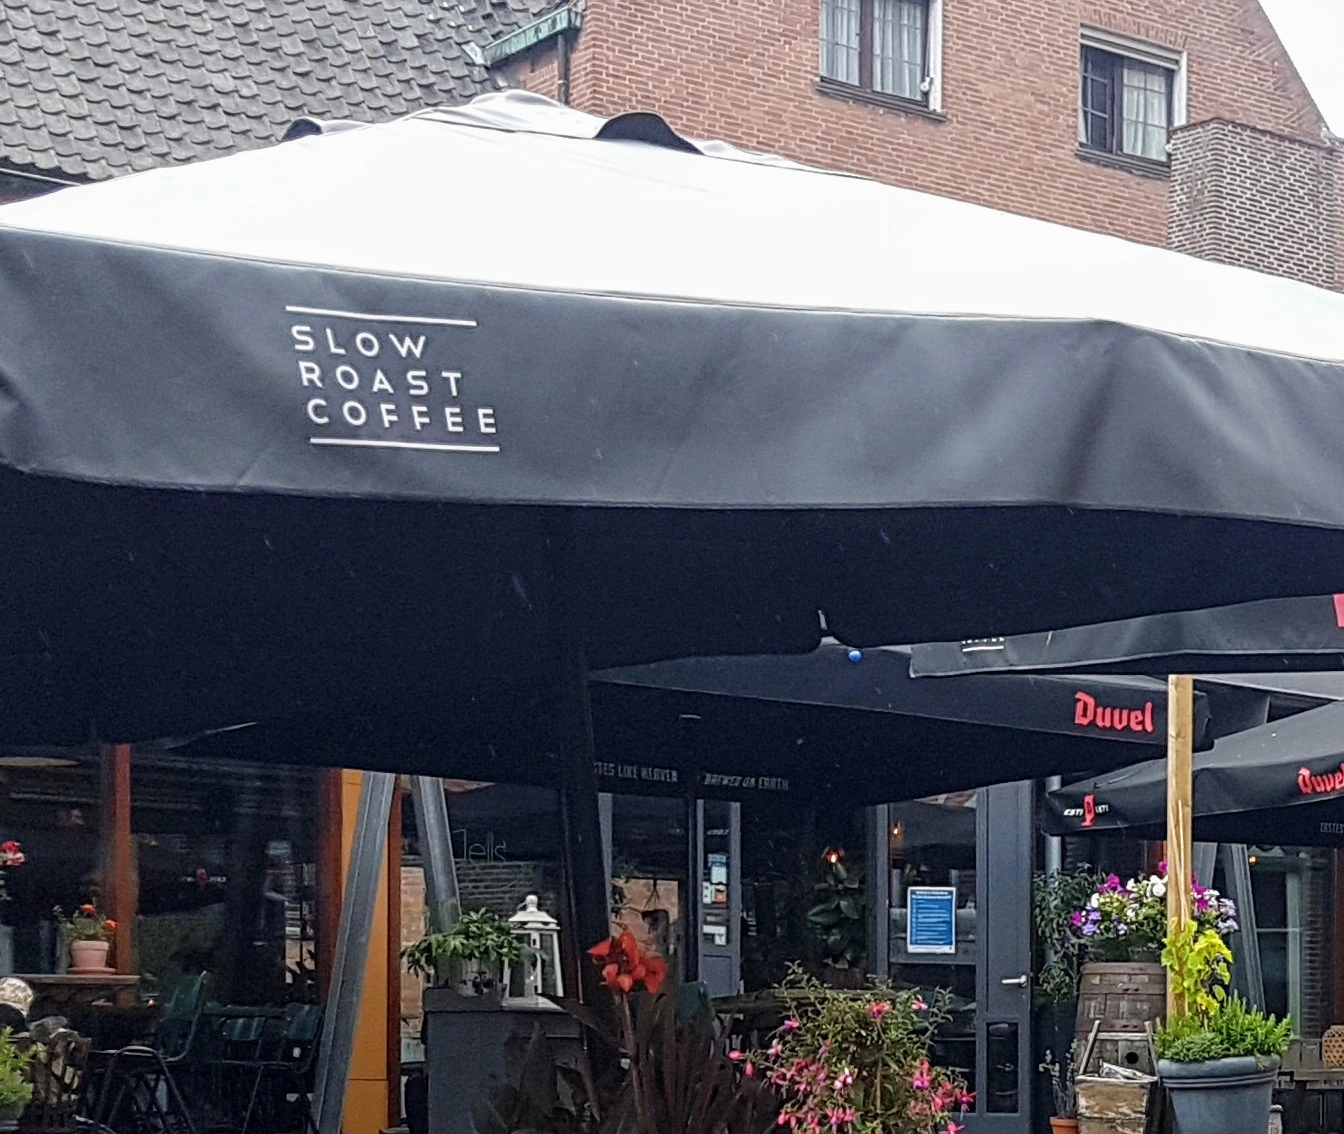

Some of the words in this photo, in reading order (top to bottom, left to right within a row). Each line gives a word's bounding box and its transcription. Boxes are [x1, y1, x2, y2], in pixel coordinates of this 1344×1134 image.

[291, 325, 427, 359] SLOW
[298, 361, 462, 397] ROAST
[306, 398, 498, 434] COFFEE
[1074, 692, 1153, 732] Duvel
